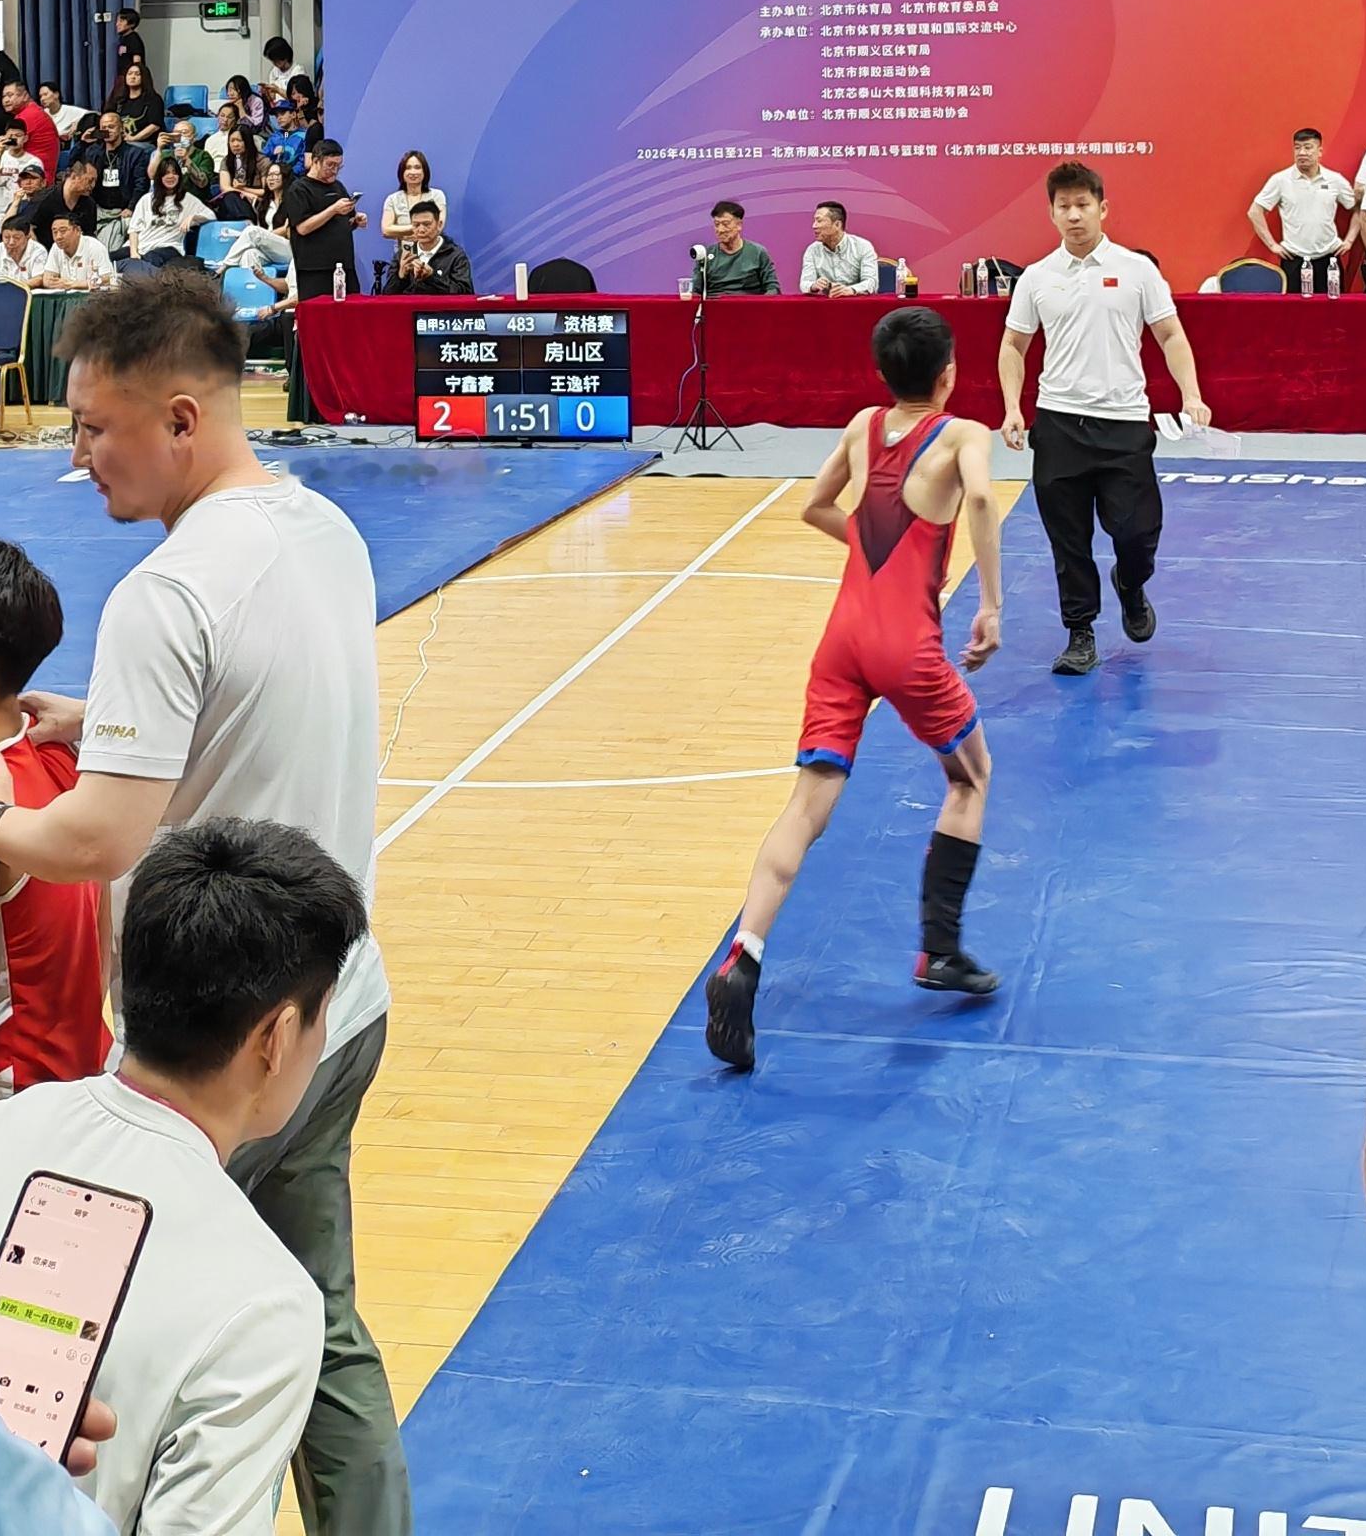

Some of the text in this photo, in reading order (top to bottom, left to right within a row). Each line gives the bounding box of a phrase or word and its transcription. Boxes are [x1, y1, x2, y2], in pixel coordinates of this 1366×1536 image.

[759, 0, 999, 18] 主办单位： 北京市体育局 北京市教育委员会
[759, 26, 814, 39] 承办单位：
[820, 44, 931, 59] 北京市顺义区体育局
[821, 65, 932, 79] 北京市摔跤运动协会
[821, 85, 993, 100] 北京芯泰山大数据科技有限公司
[821, 106, 969, 121] 北京市顺义区摔跤运动协会
[636, 147, 763, 160] 2026年4月11日至12日
[506, 316, 535, 332] 483
[563, 315, 614, 333] 资格赛
[440, 342, 605, 363] 东城区 房山区
[445, 375, 600, 394] 宁鑫豪 王逸轩
[433, 401, 596, 432] 2 1:51 0
[95, 724, 137, 739] CHINA
